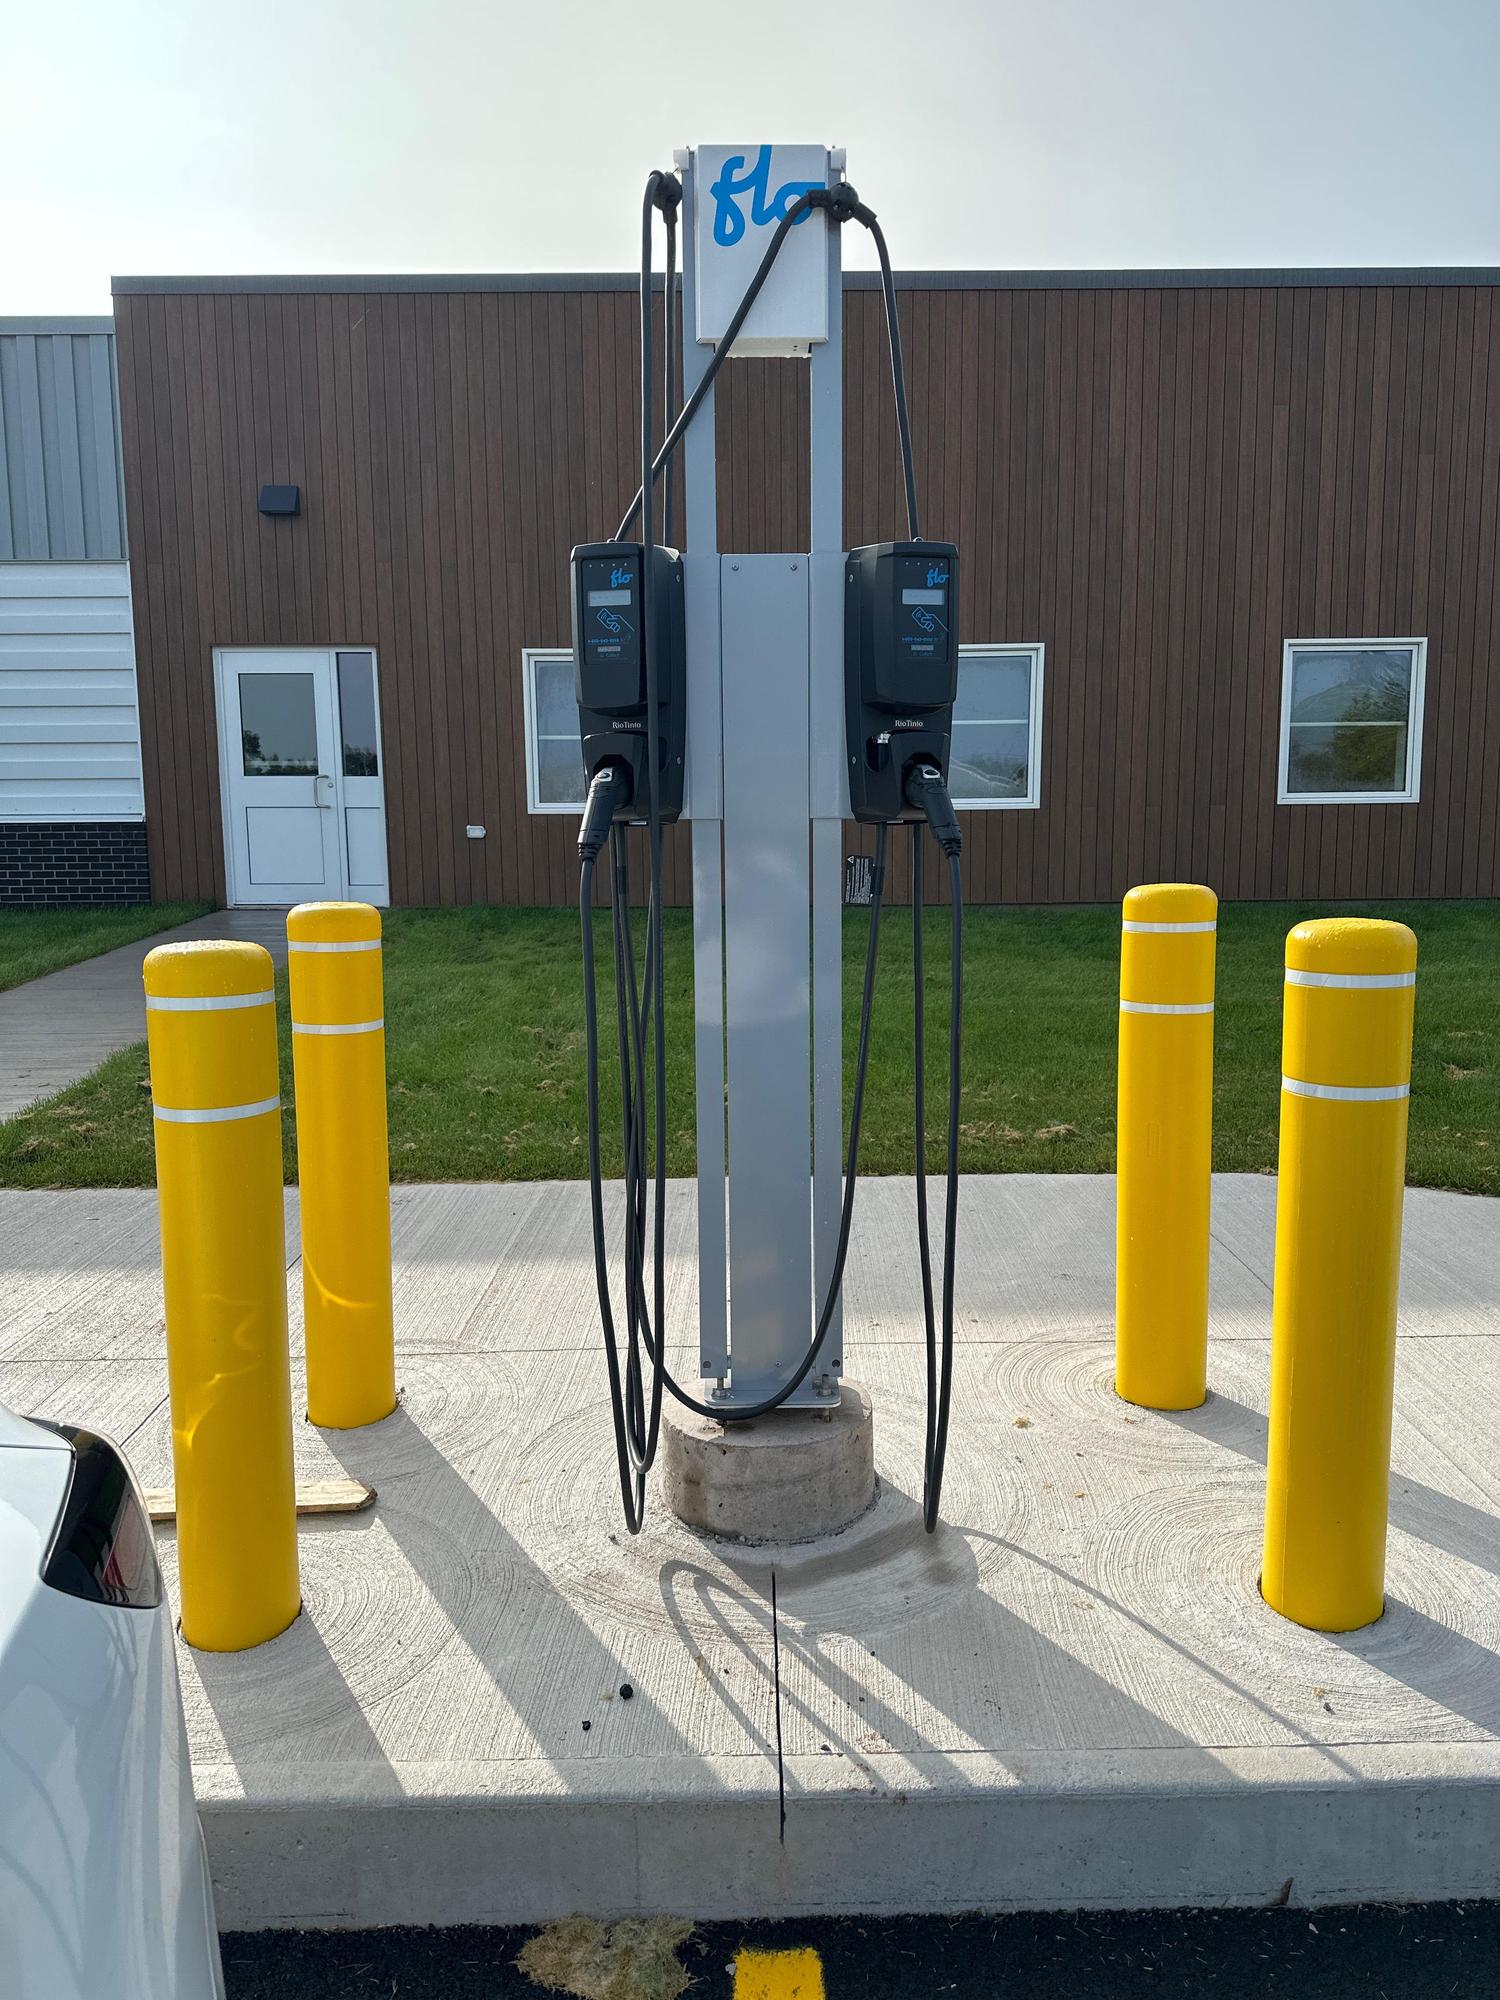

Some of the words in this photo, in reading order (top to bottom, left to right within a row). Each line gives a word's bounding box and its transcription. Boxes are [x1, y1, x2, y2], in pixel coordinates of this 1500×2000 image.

[710, 144, 826, 247] flo
[610, 567, 634, 588] flo
[926, 567, 949, 588] flo
